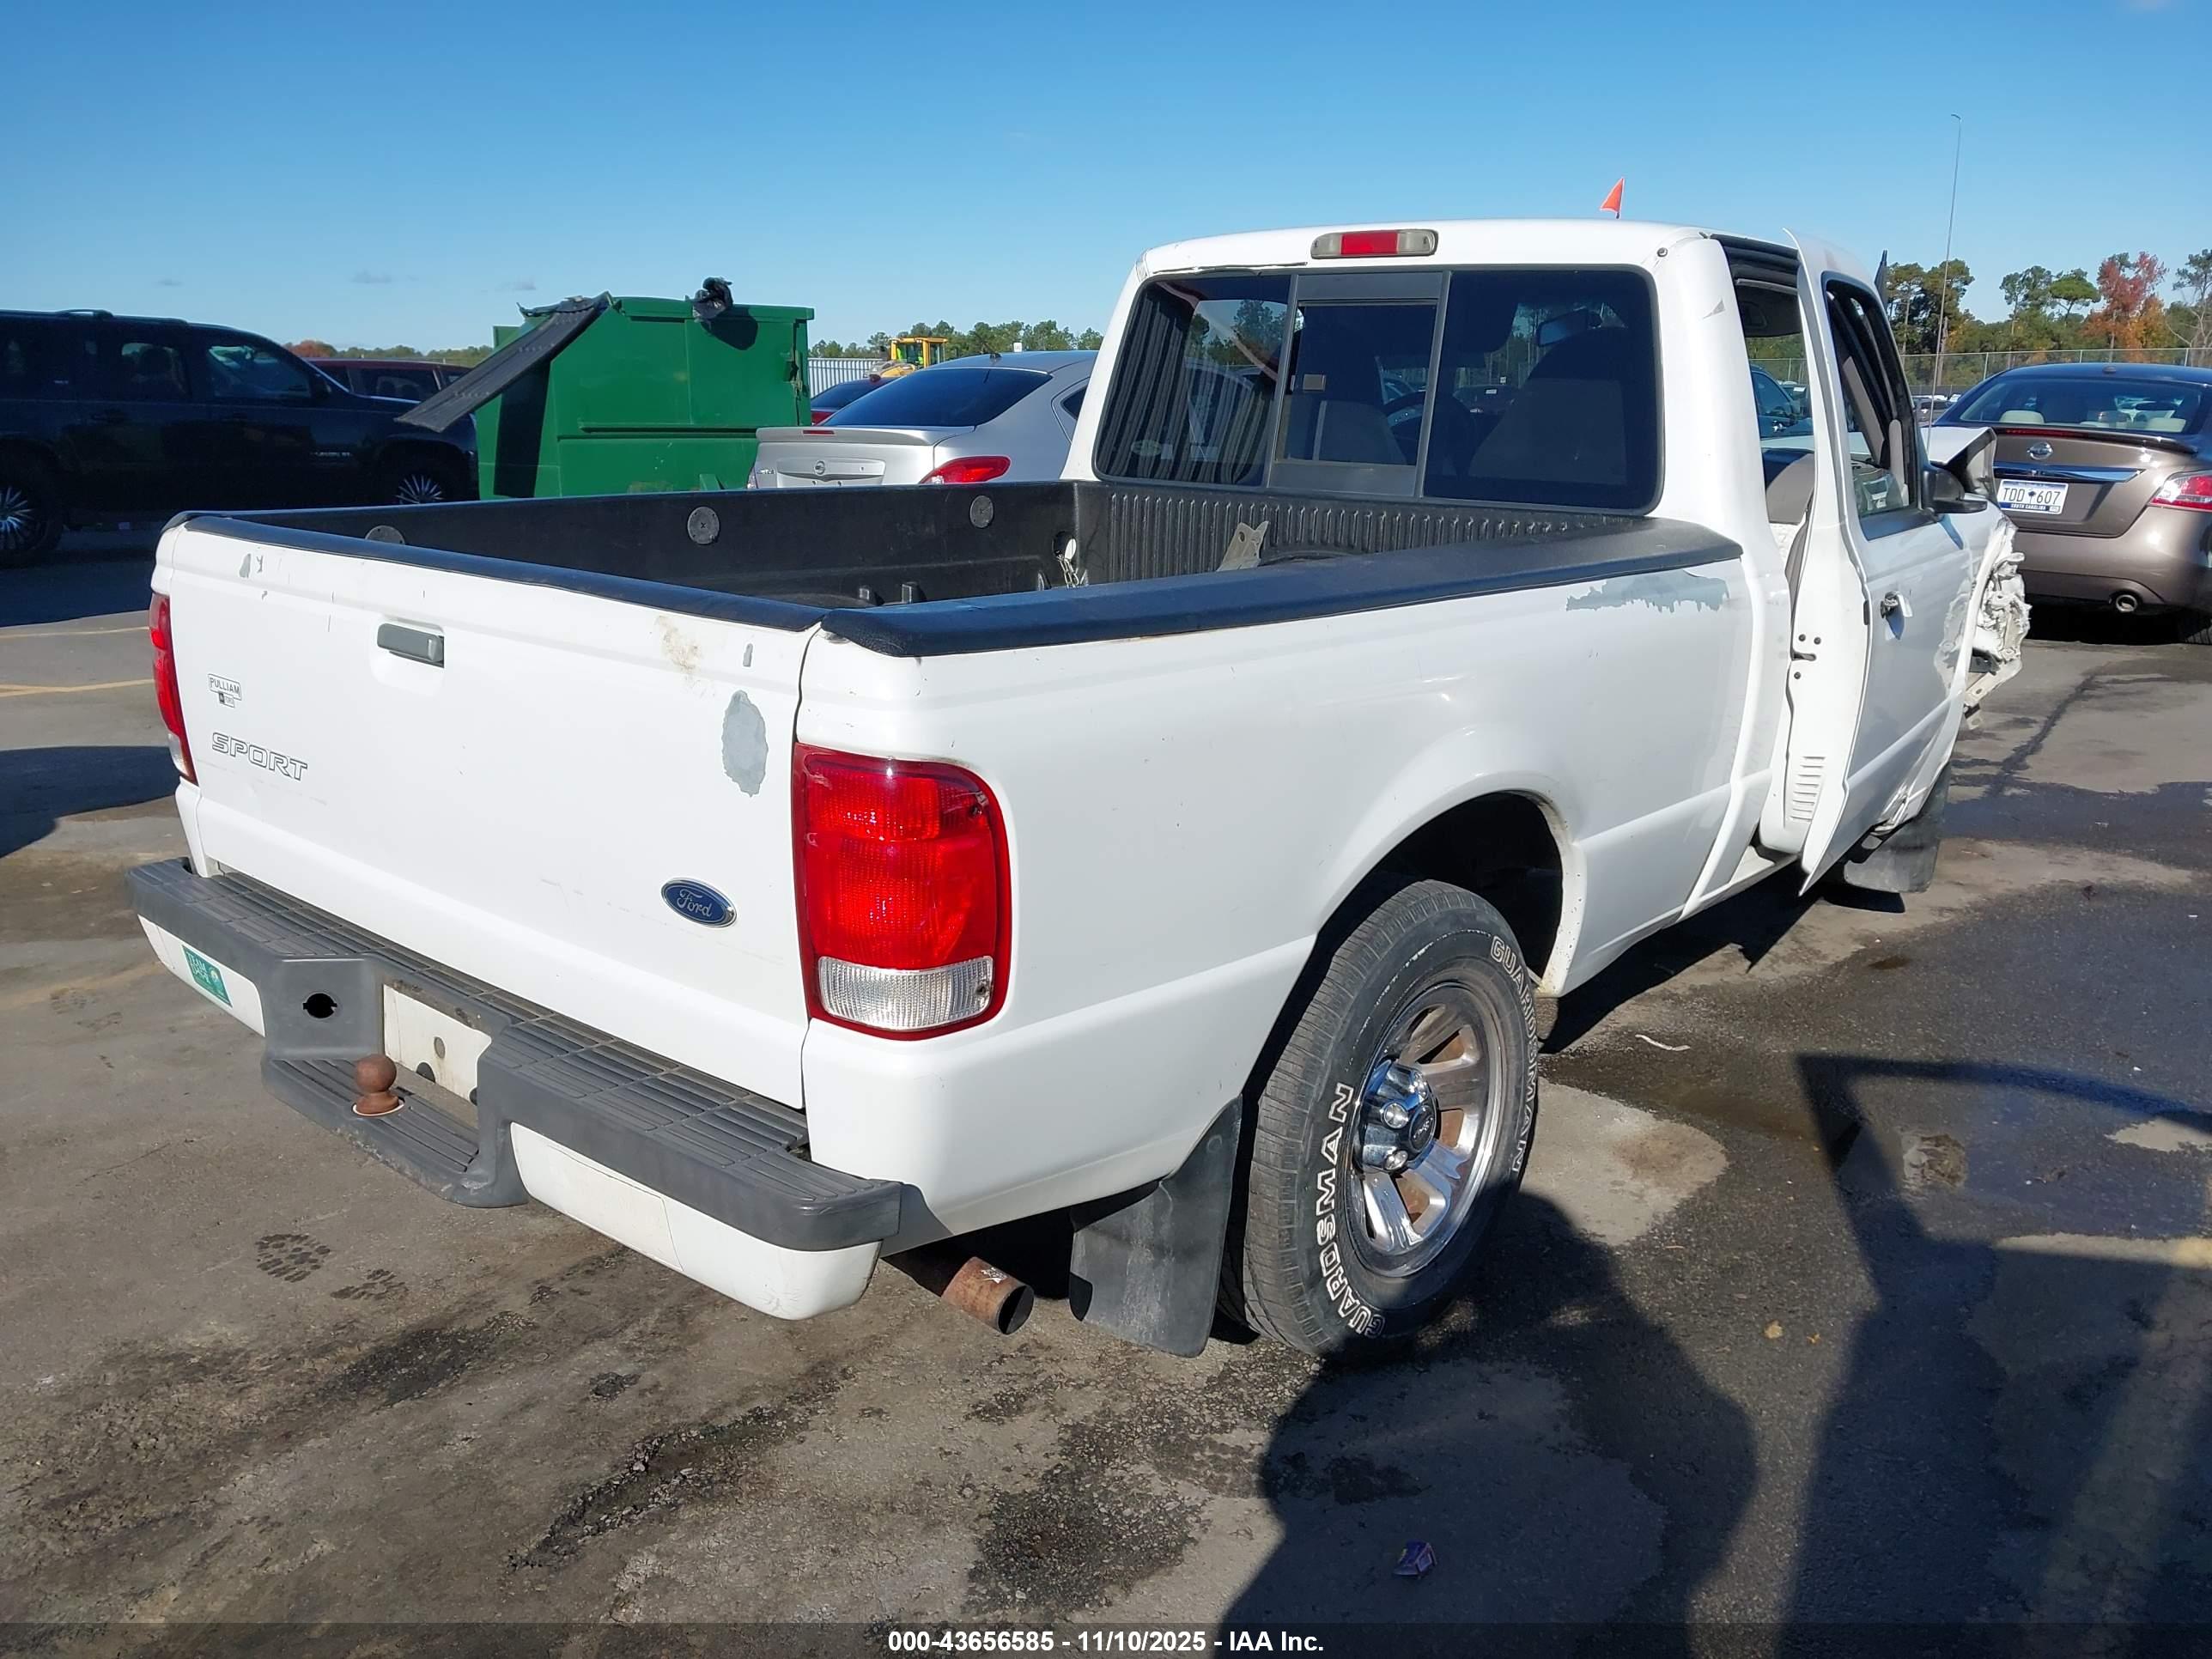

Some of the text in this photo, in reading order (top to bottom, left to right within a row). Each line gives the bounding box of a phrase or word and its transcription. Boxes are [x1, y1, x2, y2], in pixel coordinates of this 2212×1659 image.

[2036, 490, 2062, 505] 607
[210, 677, 240, 697] PULLIAM
[212, 732, 307, 781] SPORT
[677, 888, 714, 917] Ford
[1316, 1082, 1386, 1339] GUARDSMAN
